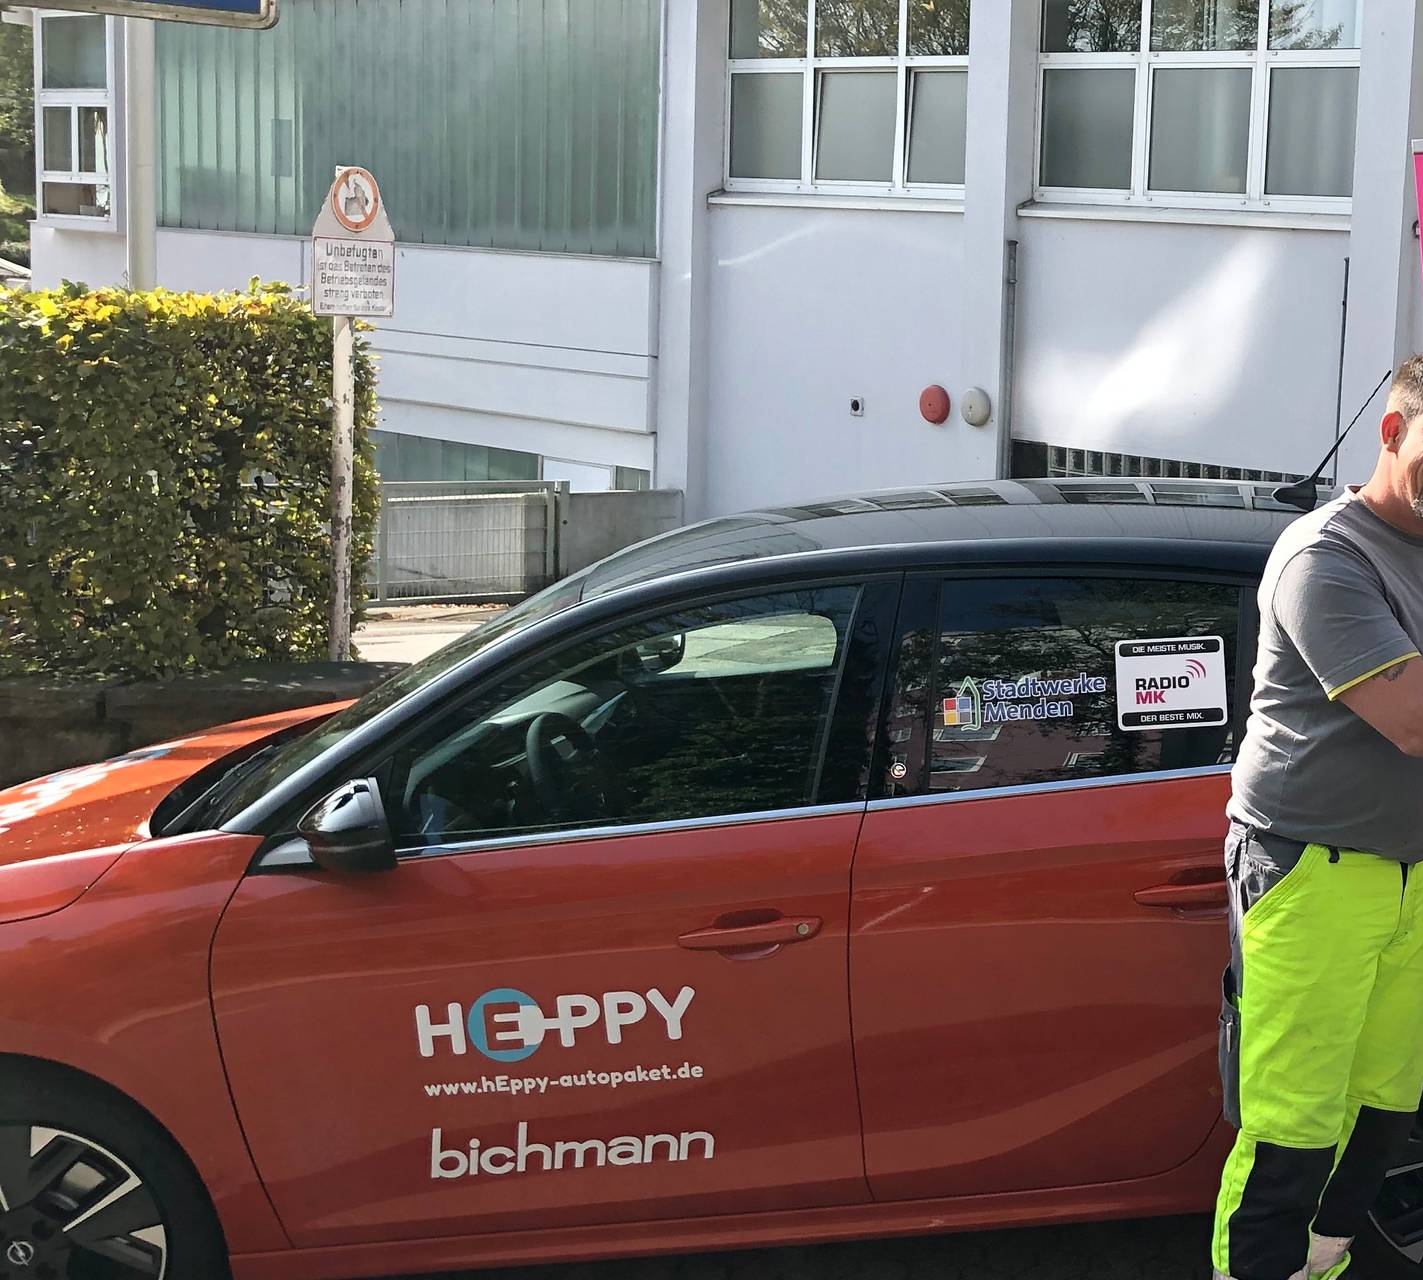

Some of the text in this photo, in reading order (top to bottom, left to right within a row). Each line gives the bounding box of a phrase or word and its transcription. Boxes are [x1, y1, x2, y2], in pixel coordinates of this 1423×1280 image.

[326, 242, 383, 261] Unbefugten
[344, 260, 376, 273] Betreten
[324, 288, 383, 301] streng verboten
[1147, 644, 1176, 652] MEISTE
[1178, 643, 1206, 651] MUSIK.
[982, 672, 1106, 700] Stadtwerke
[1135, 675, 1189, 690] RADIO
[1136, 690, 1166, 704] MK
[984, 698, 1073, 722] Menden
[1159, 713, 1184, 721] BESTE
[1187, 712, 1204, 720] MIX.
[415, 986, 696, 1060] HEPPY
[424, 1062, 704, 1096] www.hEppy-autopaket.de
[431, 1121, 715, 1179] bichmann
